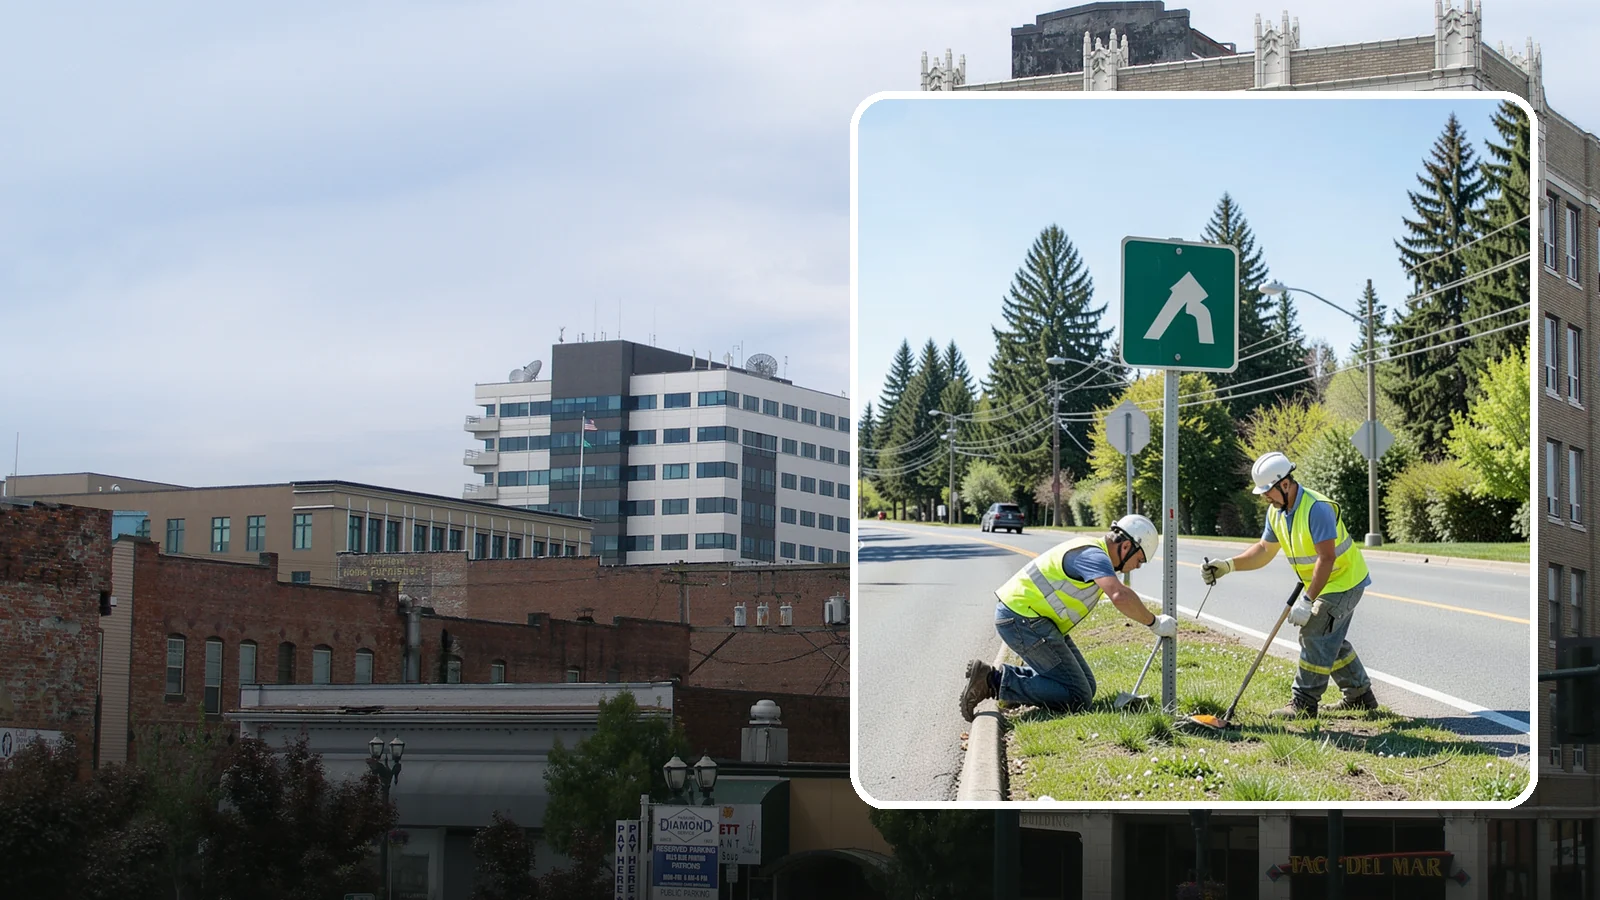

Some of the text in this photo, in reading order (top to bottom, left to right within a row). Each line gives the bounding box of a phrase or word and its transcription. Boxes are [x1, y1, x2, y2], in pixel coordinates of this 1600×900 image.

[660, 818, 713, 832] DIAMOND
[1022, 815, 1070, 827] BUILDING
[656, 845, 716, 854] RESERVED PARKING
[616, 825, 625, 893] PAY HERE
[627, 824, 637, 893] PAY HERE
[671, 862, 701, 870] PATRONS
[1289, 855, 1442, 877] TAC DEL MAR
[660, 888, 710, 898] PUBLIC PARKING
